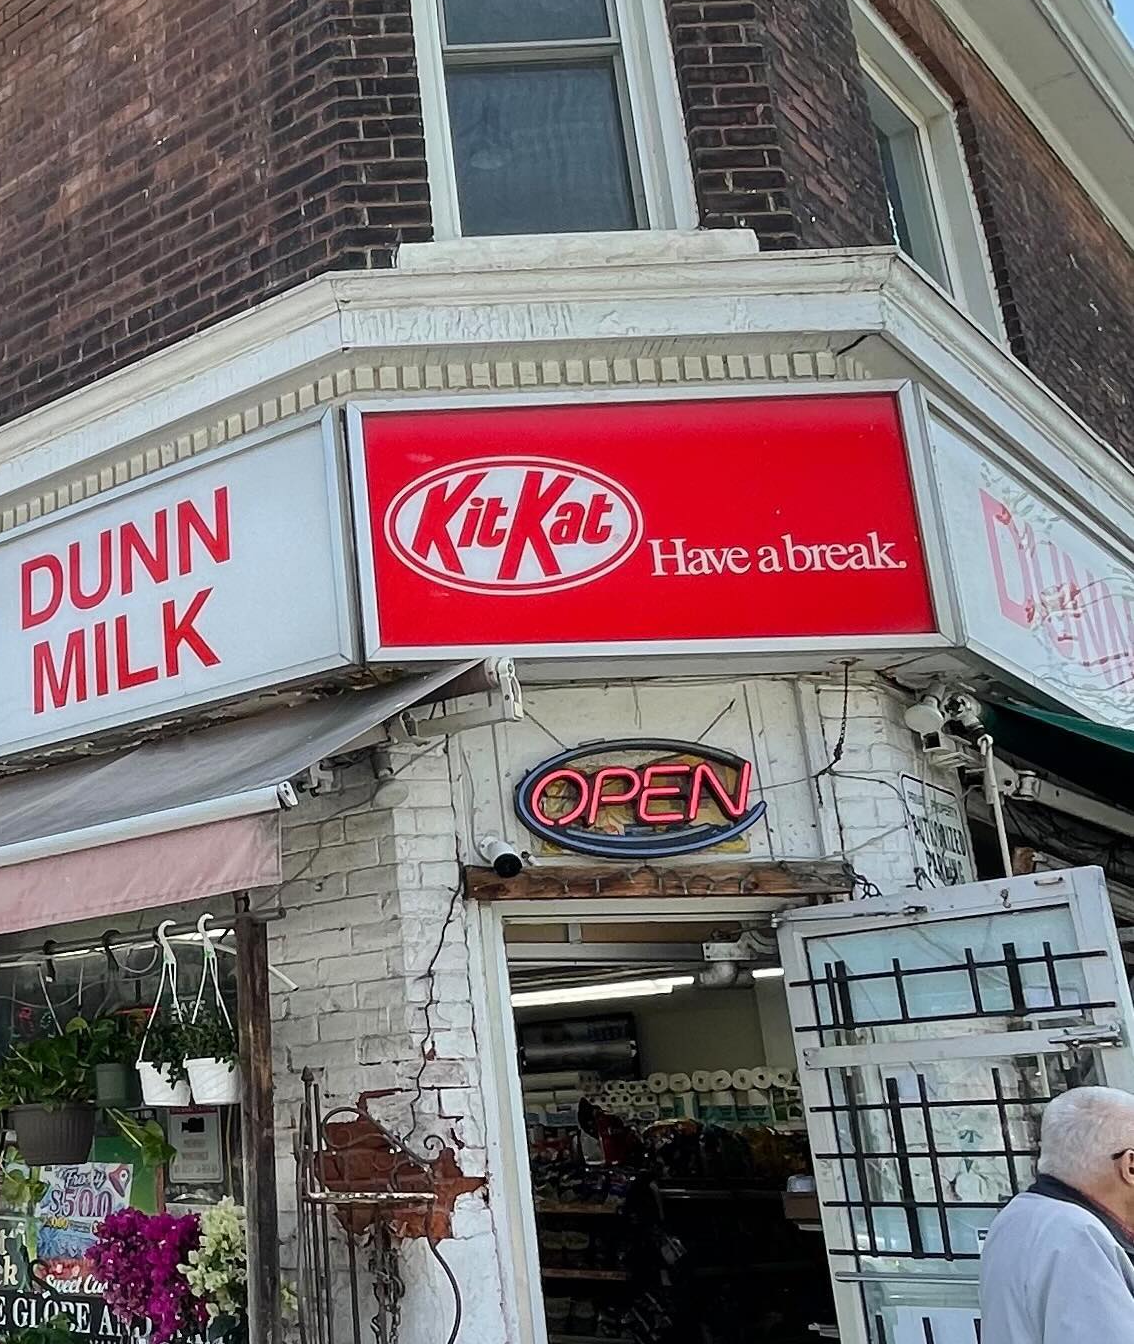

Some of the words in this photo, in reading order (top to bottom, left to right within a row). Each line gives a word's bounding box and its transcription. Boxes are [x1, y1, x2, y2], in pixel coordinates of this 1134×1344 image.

[20, 486, 231, 630] DUNN
[647, 538, 751, 576] Have
[757, 545, 783, 572] a
[781, 531, 907, 571] break.
[32, 586, 222, 715] MILK
[531, 760, 752, 826] OPEN
[46, 1274, 83, 1294] Sweet
